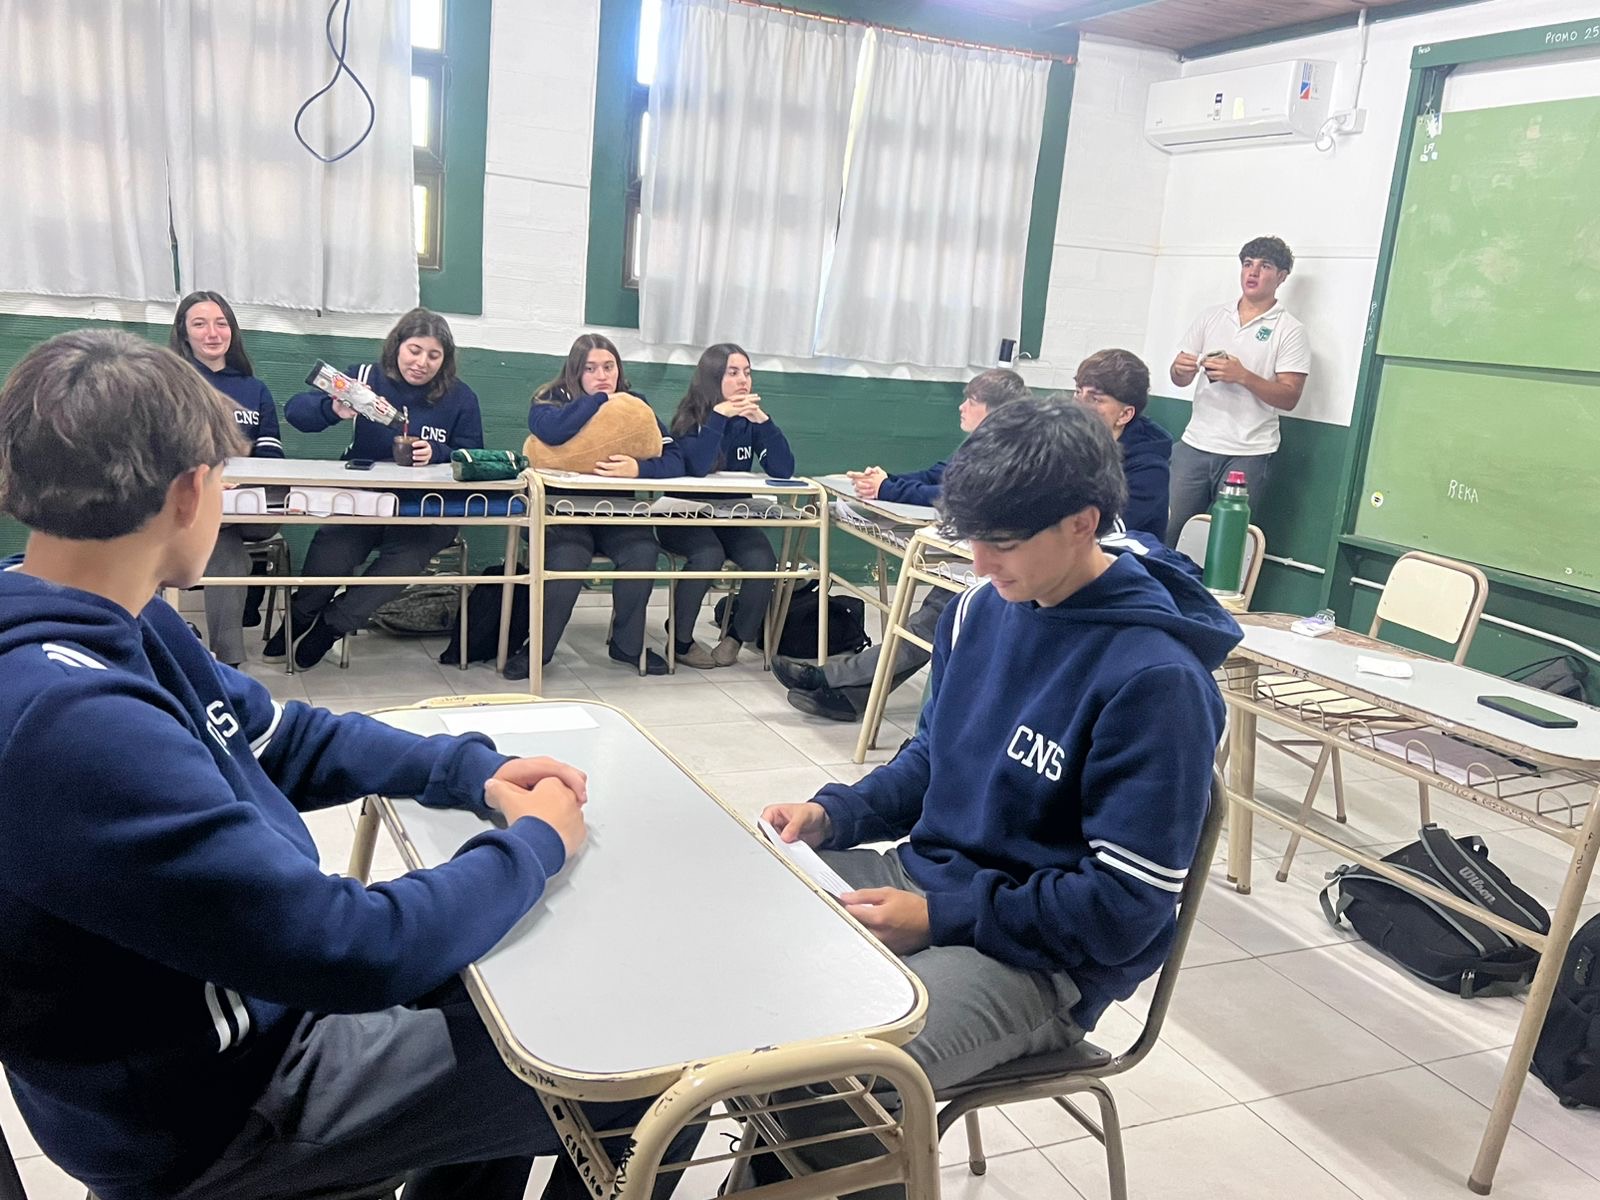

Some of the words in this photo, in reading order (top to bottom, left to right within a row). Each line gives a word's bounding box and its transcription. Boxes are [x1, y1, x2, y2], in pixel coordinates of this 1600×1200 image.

[1583, 25, 1600, 40] 25
[233, 410, 260, 425] CNS
[420, 425, 447, 443] CNS
[736, 446, 752, 461] CN
[1006, 724, 1065, 781] CNS
[1458, 865, 1496, 905] Wilson
